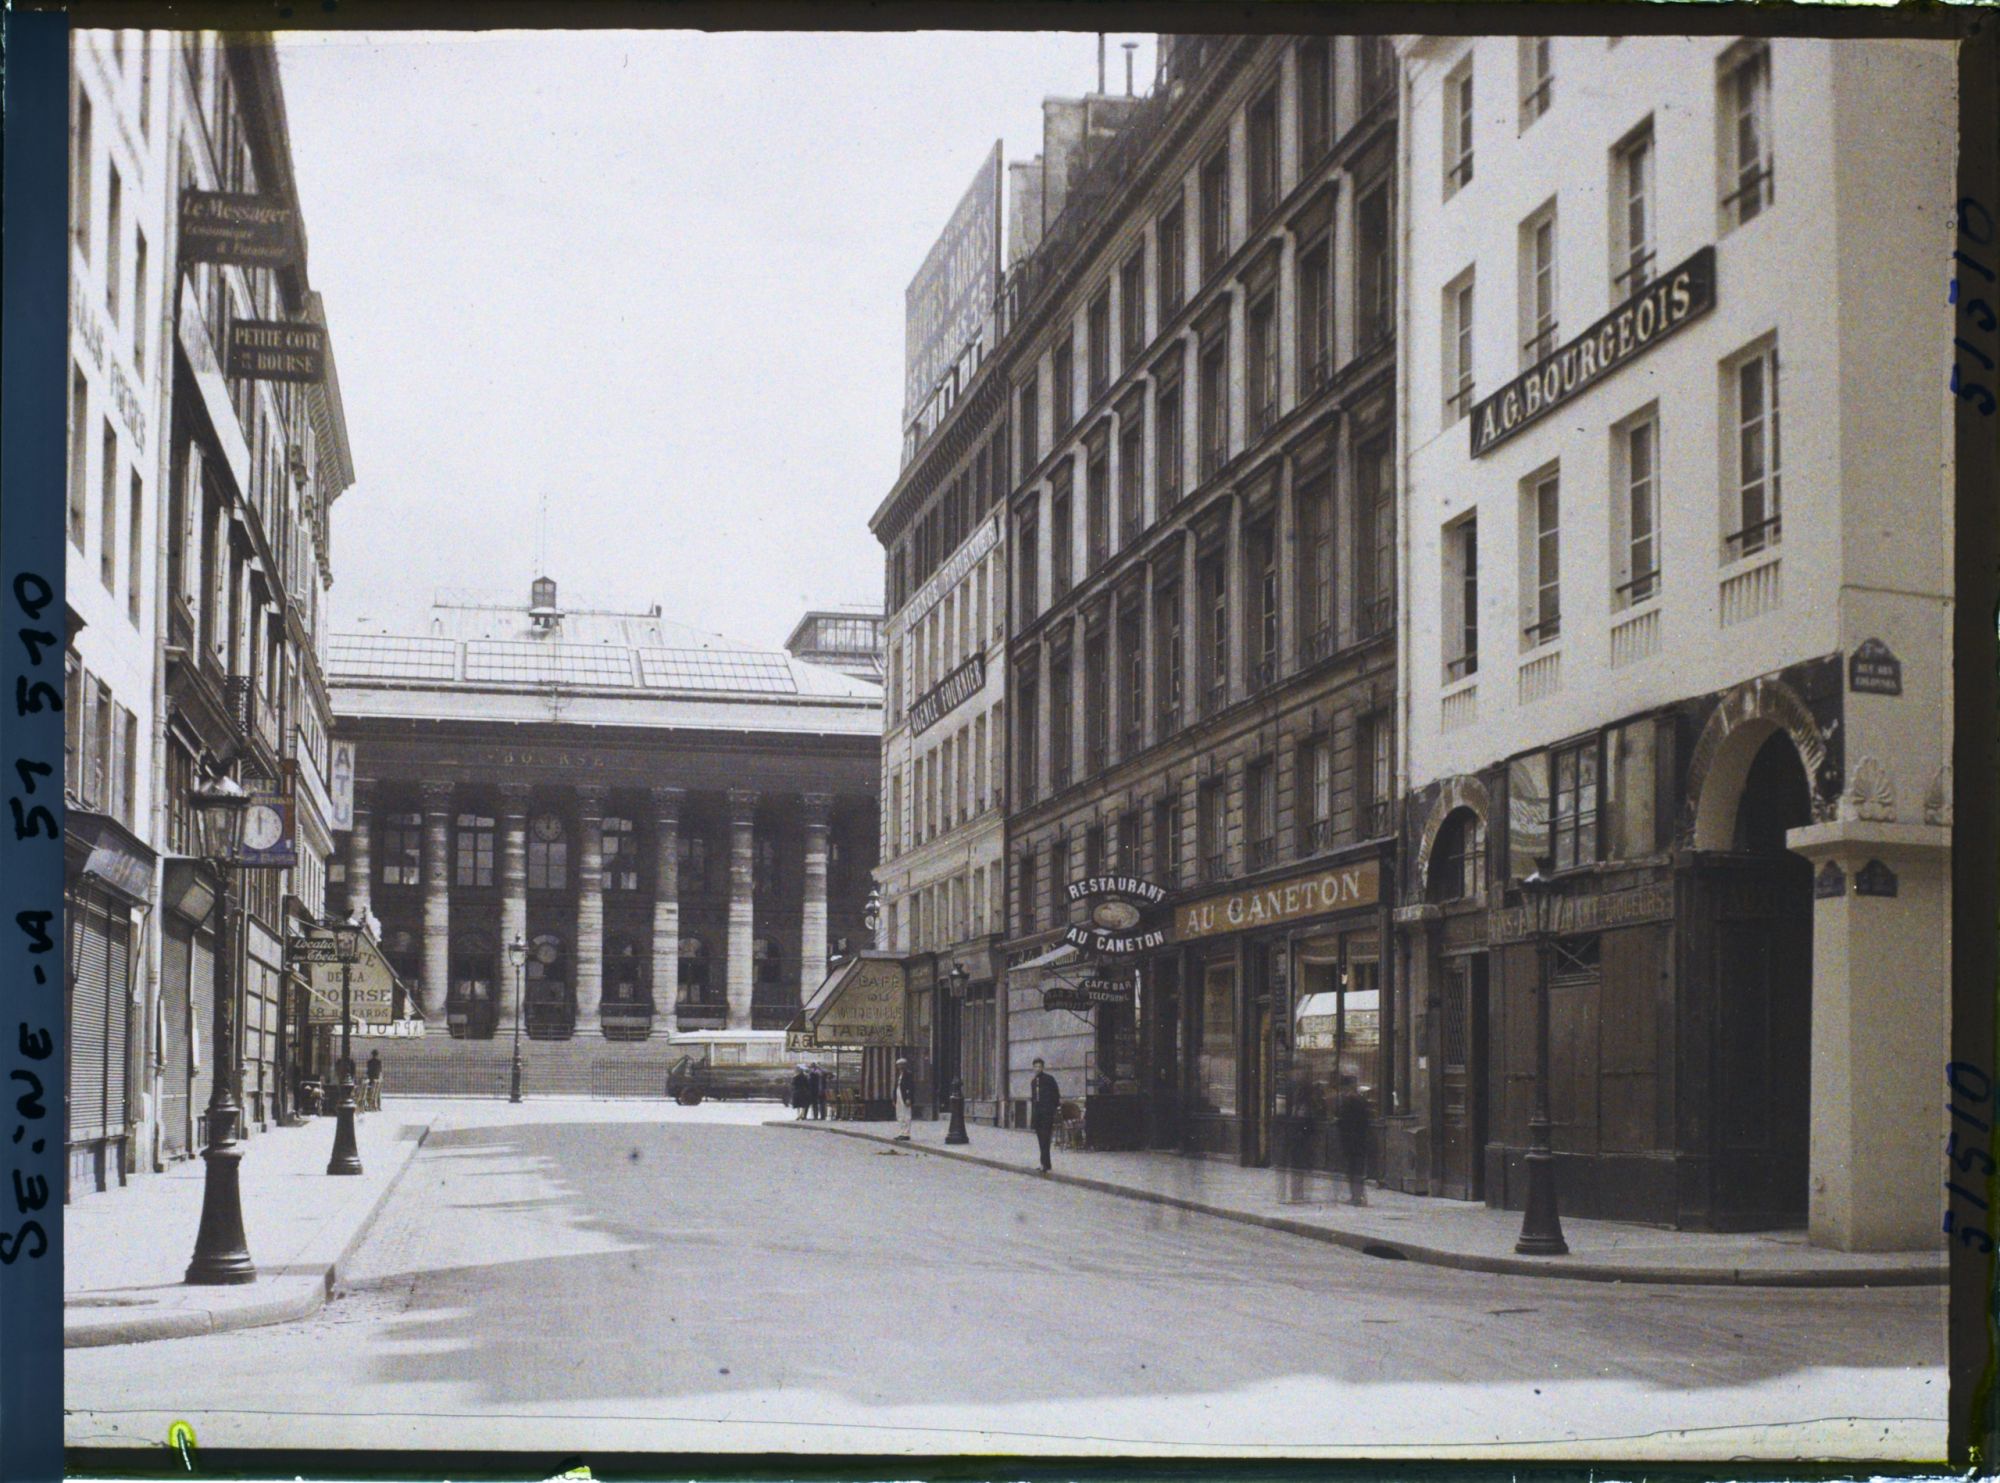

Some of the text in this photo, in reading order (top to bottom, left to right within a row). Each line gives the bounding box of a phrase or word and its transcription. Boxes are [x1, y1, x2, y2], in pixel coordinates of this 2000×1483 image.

[235, 327, 282, 346] PETITE
[258, 352, 313, 374] BOURSE
[911, 660, 983, 736] AGENCE FOURNIER
[1068, 876, 1167, 902] RESTAURANT
[1185, 870, 1361, 934] AU CANETON
[294, 938, 337, 949] Locatio
[1066, 927, 1165, 952] AU CANETON
[315, 988, 392, 1003] BORSE
